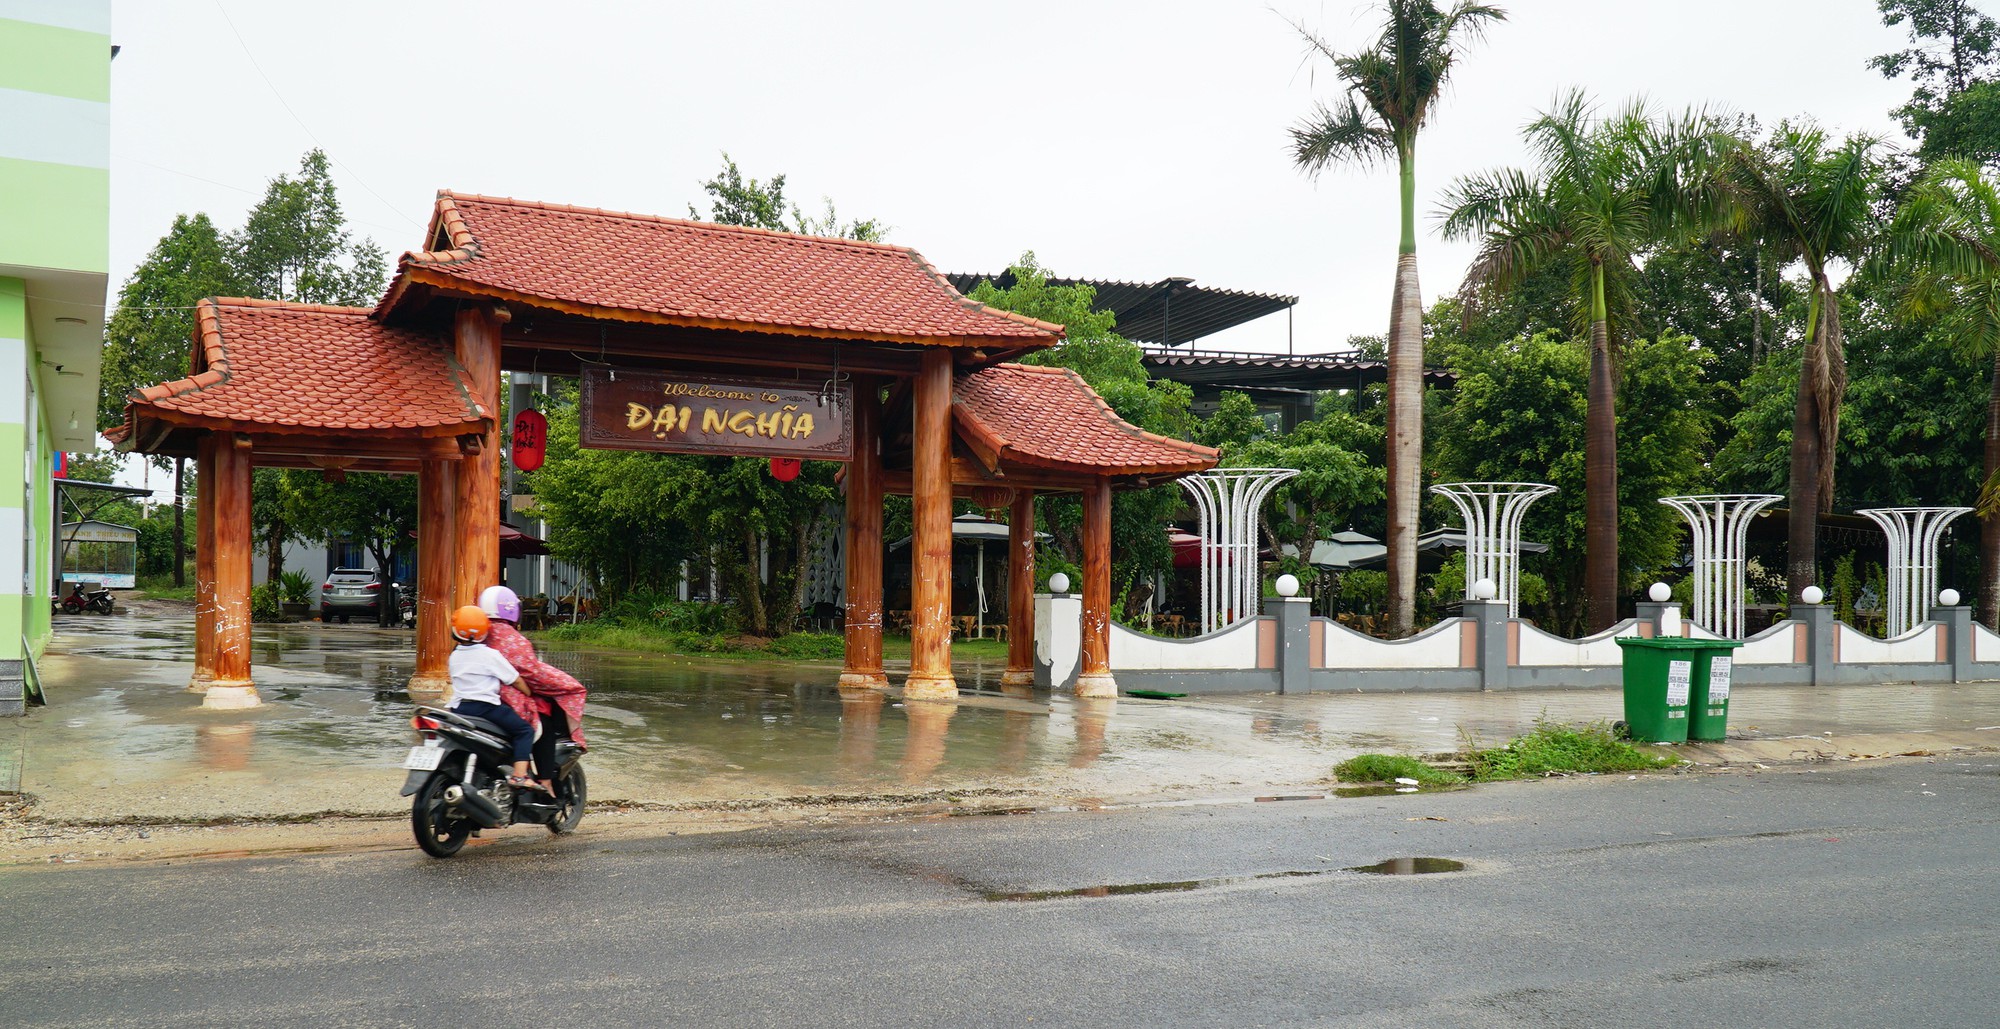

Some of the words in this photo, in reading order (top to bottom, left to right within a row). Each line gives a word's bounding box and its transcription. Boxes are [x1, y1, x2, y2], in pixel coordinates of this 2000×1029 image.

[664, 383, 754, 401] Welcome
[760, 390, 780, 403] to
[625, 401, 693, 440] ĐẠI
[701, 404, 815, 440] NGHĨA
